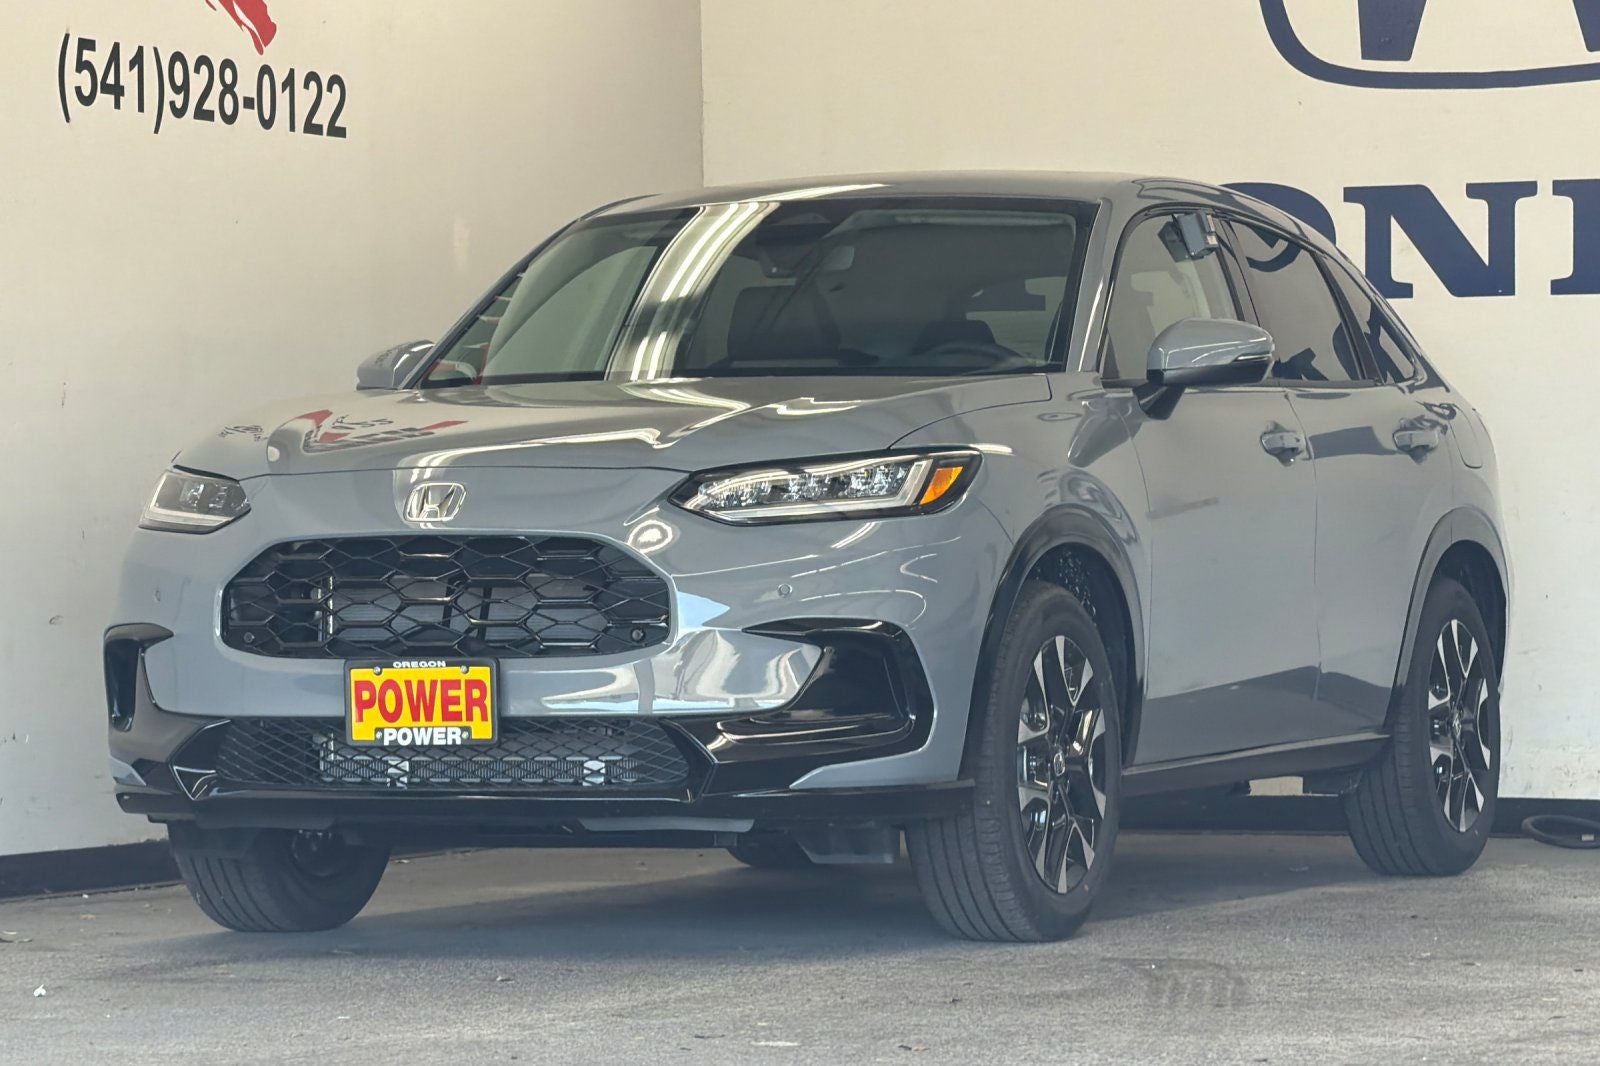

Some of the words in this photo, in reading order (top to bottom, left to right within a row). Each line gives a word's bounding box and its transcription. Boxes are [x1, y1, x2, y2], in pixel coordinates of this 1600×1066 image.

[58, 32, 347, 138] (541)928-0122
[392, 660, 447, 669] OREGON
[354, 678, 489, 724] POWER
[383, 727, 462, 746] POWER
